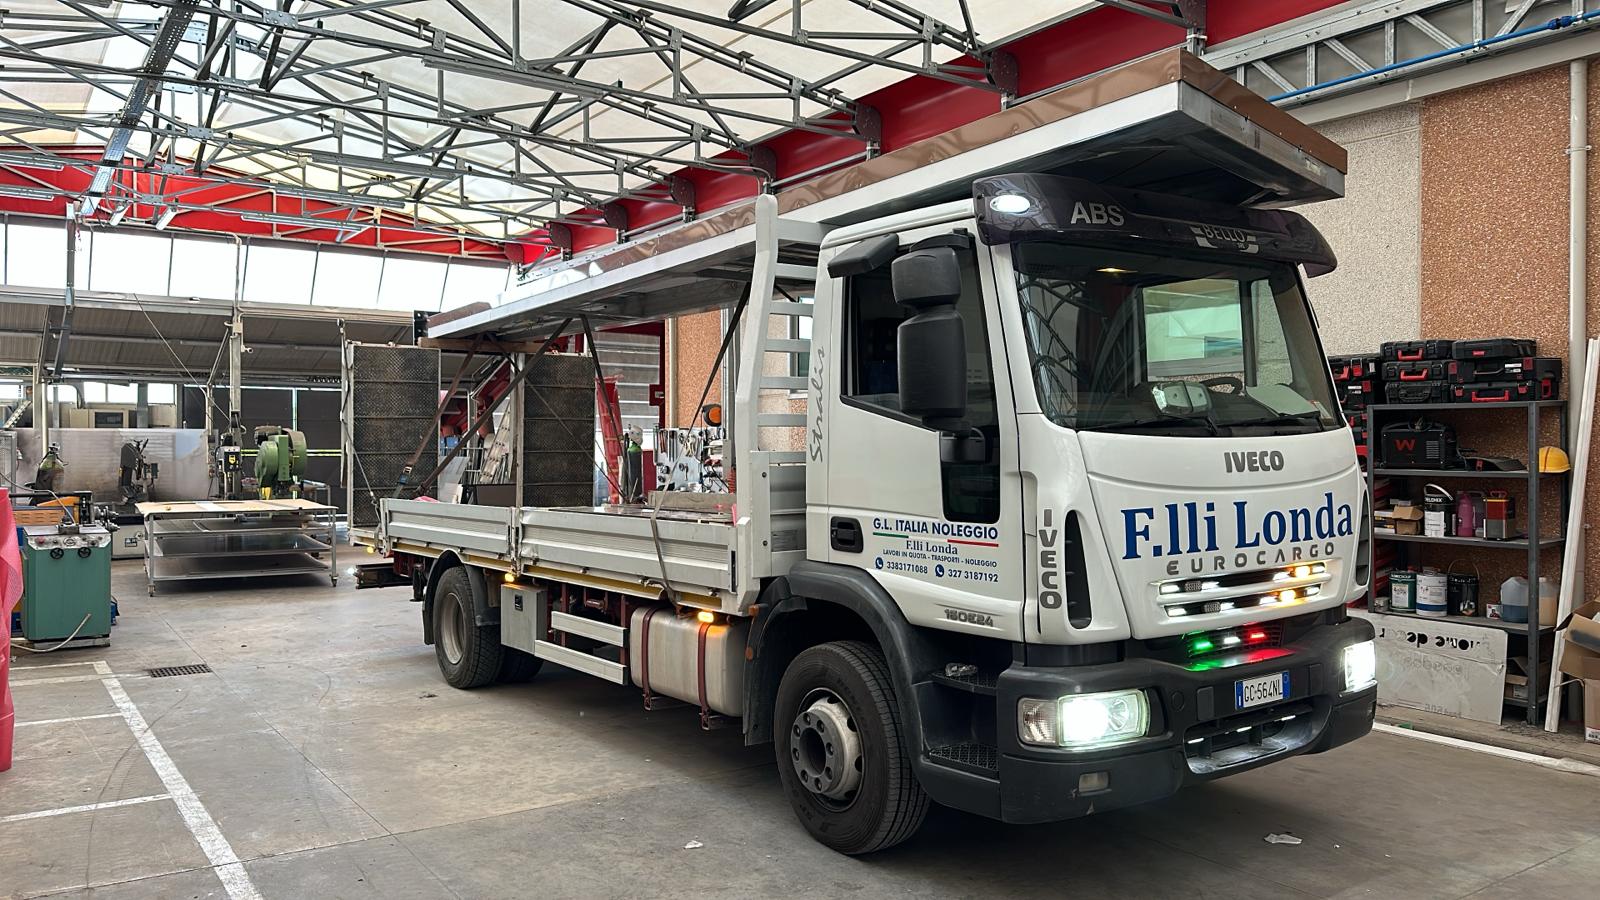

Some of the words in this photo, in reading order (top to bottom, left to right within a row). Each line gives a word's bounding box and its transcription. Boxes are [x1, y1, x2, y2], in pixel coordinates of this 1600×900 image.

[1070, 201, 1125, 226] ABS
[1203, 224, 1246, 243] BELLO
[1223, 450, 1285, 474] IVECO
[873, 517, 893, 531] G.L.
[895, 519, 929, 534] ITALIA
[931, 522, 999, 540] NOLEGGIO
[1120, 501, 1220, 560] F.lli
[1233, 492, 1354, 549] Londa
[882, 548, 901, 557] LAVORI
[931, 554, 960, 564] TRASPORTI
[965, 557, 998, 568] NOLEGGIO
[925, 541, 959, 555] Londa
[1038, 508, 1063, 610] IVECO
[1166, 541, 1335, 576] EUROCARGO
[947, 568, 962, 578] 327
[964, 570, 999, 583] 3187192
